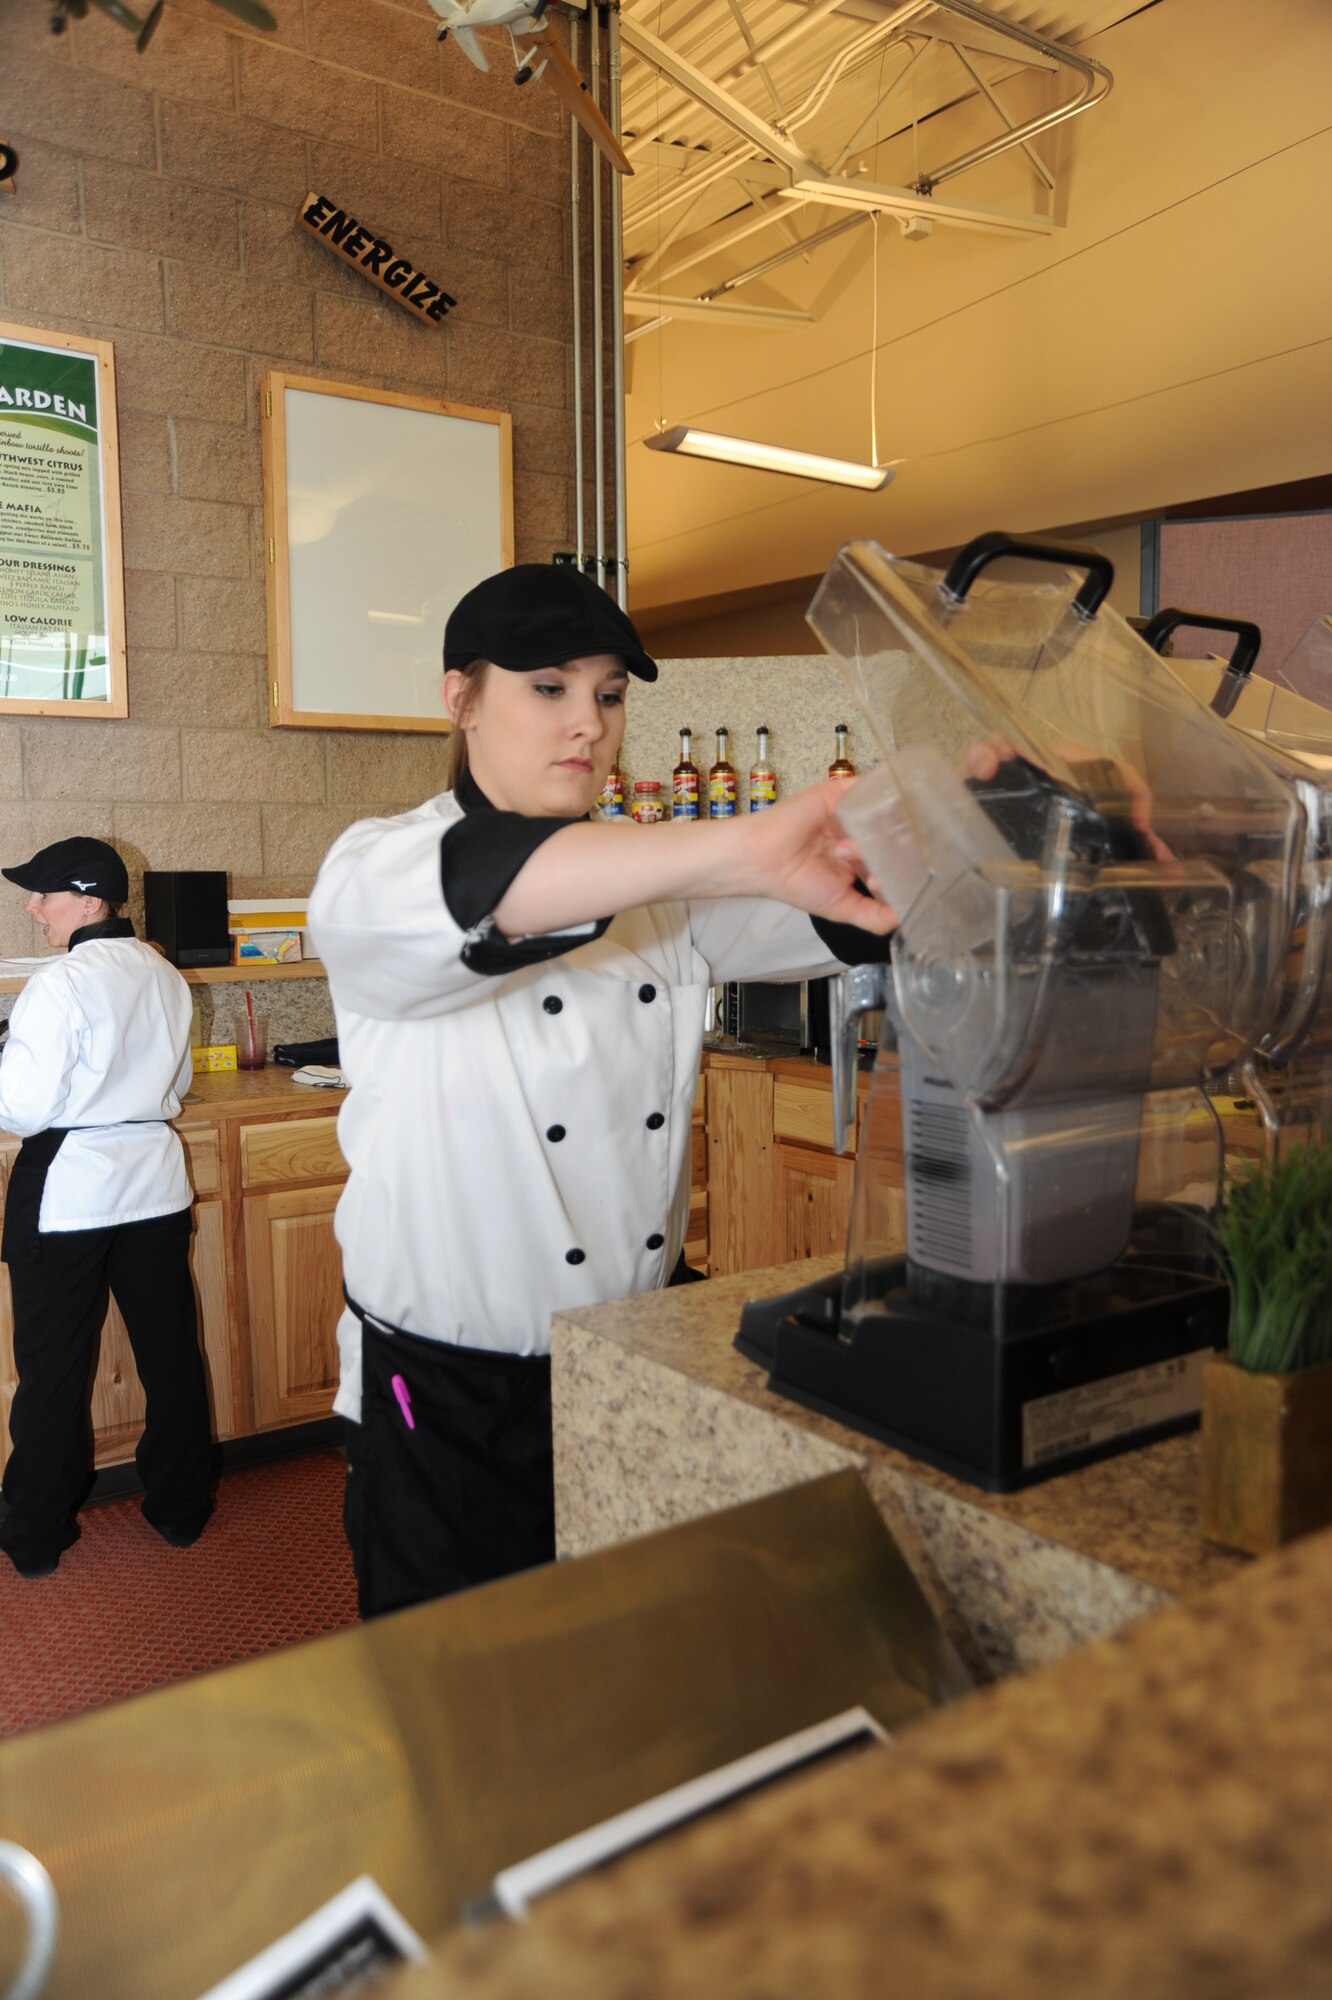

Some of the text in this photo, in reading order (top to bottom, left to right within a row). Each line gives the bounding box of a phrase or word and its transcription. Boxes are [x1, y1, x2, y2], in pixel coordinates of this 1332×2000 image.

[303, 196, 458, 322] ENERGIZE
[25, 443, 55, 453] tortilla
[47, 460, 83, 471] CITRUS
[6, 503, 42, 513] MAFIA
[15, 525, 46, 534] cranberries
[22, 560, 76, 573] DRESSINGS
[17, 575, 50, 584] BALSAMIC
[53, 578, 80, 586] ITALIAN
[25, 589, 50, 597] GARLIC
[20, 595, 48, 603] TEQUILA
[46, 604, 80, 612] MUSTARD
[4, 614, 73, 627] LOW CALORIE
[9, 623, 38, 631] ITALIAN
